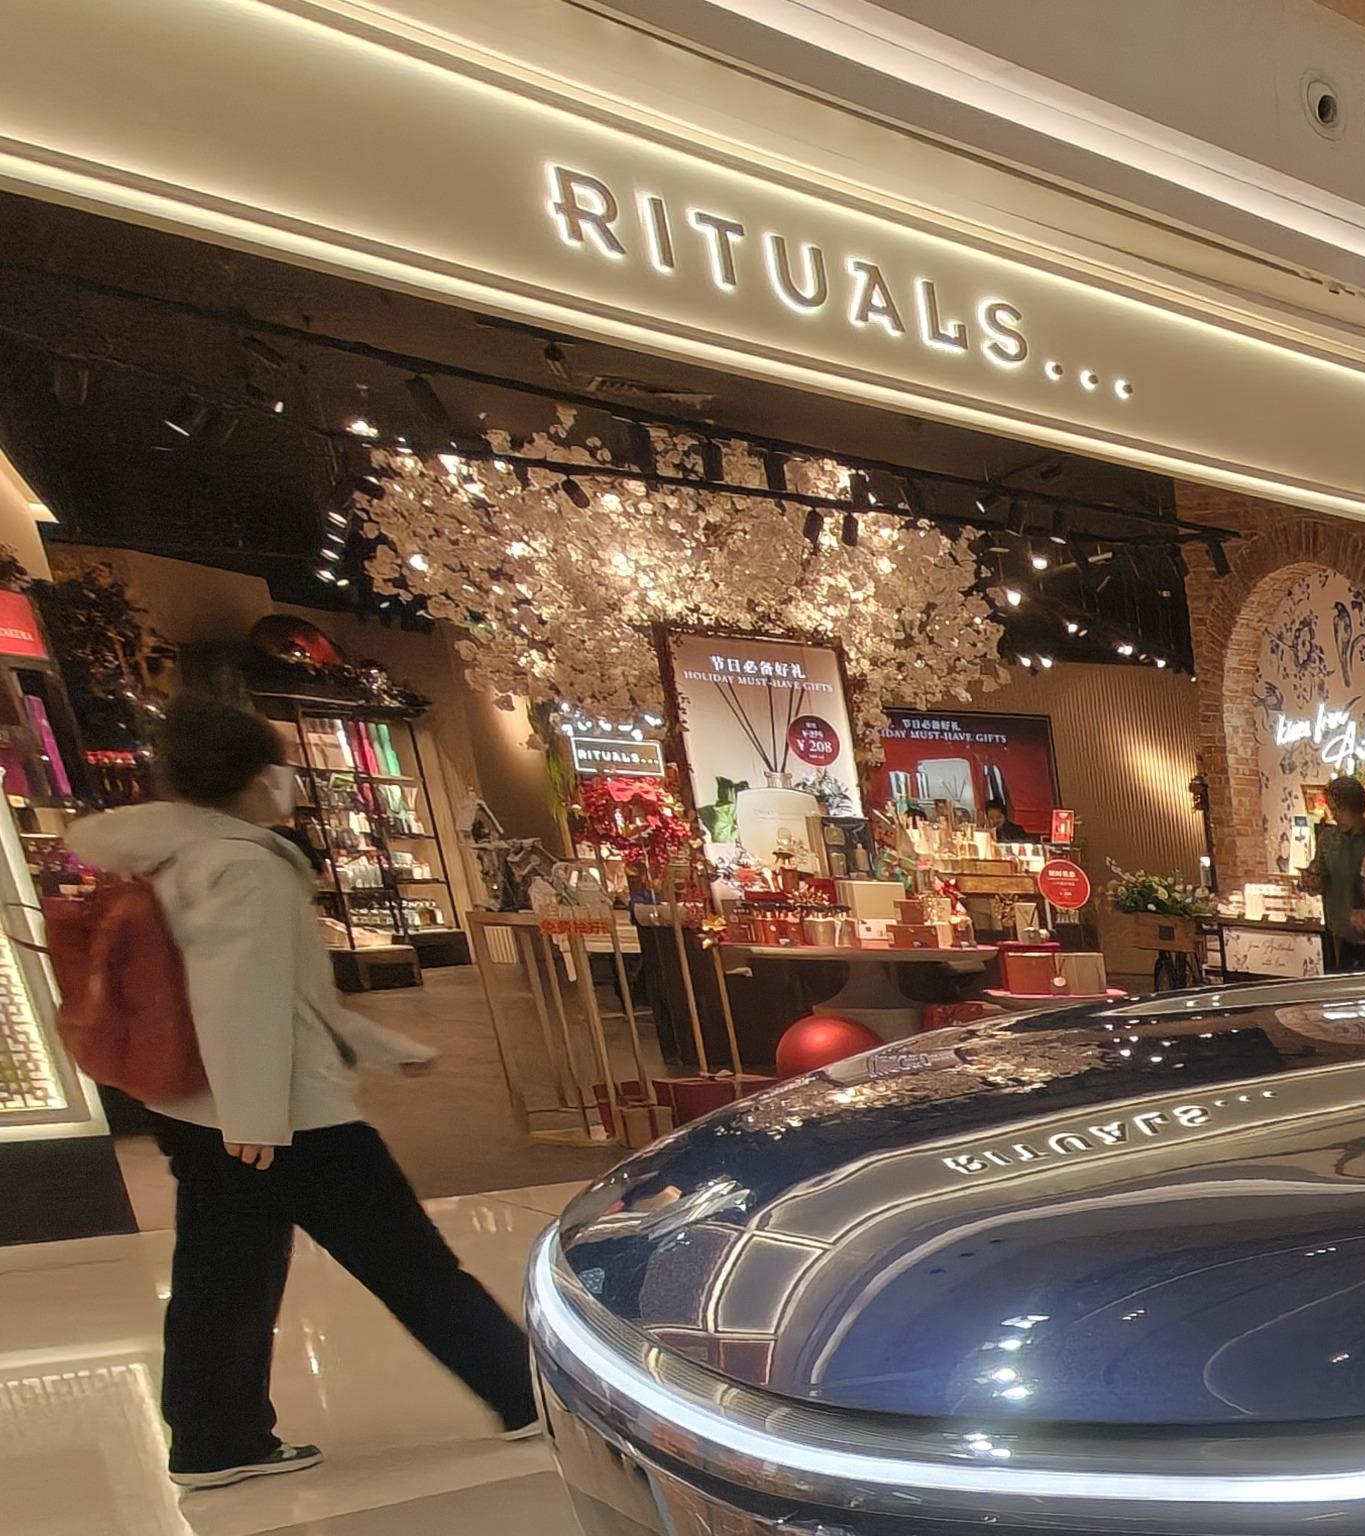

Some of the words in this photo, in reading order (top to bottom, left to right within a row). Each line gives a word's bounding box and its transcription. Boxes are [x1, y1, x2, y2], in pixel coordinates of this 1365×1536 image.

[550, 163, 1134, 397] RITUALS...
[711, 655, 806, 679] 节日必备好礼
[684, 671, 735, 684] HOLIDAY
[738, 677, 800, 690] MUST-HAVE
[802, 682, 833, 692] GIFTS
[809, 740, 833, 753] 208
[910, 731, 975, 742] MUST-HAVE
[975, 733, 1007, 744] GIFTS
